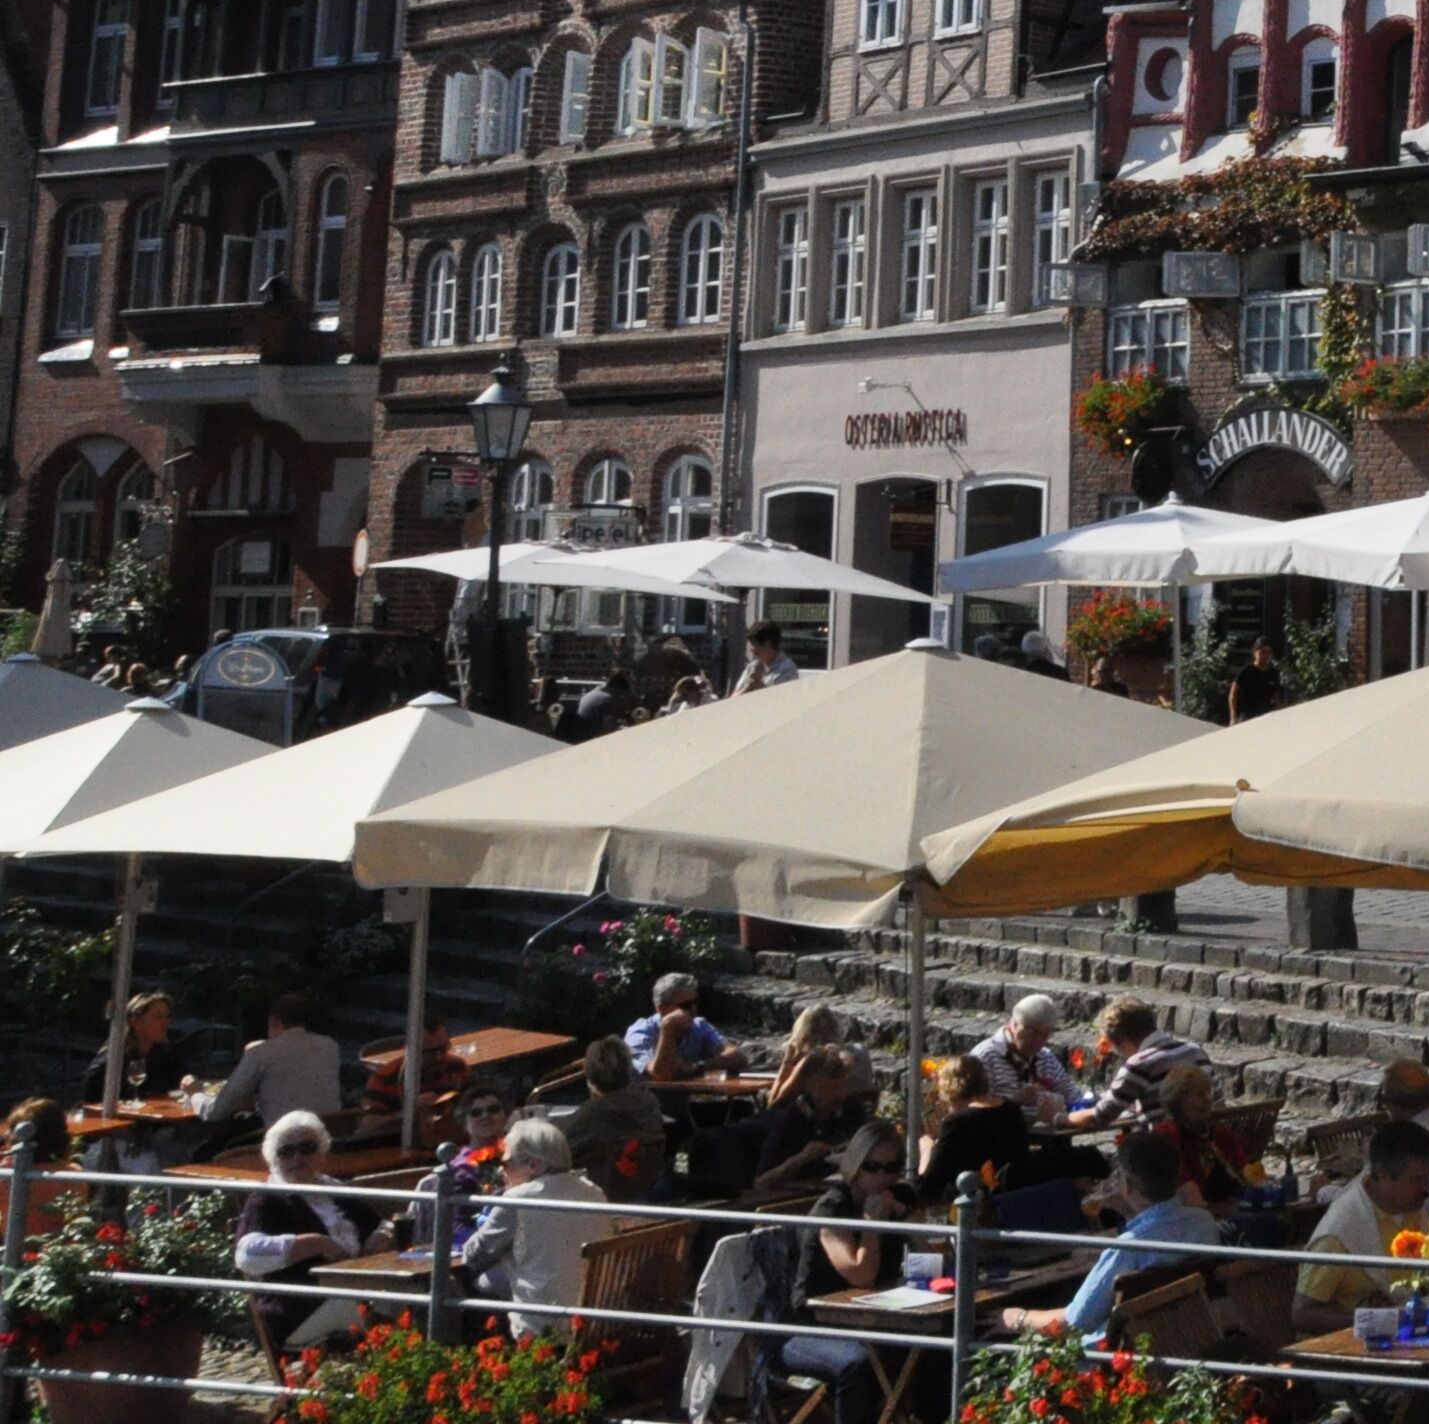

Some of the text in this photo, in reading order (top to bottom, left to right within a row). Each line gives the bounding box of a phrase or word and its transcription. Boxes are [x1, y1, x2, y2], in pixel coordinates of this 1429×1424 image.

[844, 408, 966, 447] OSTERIA RUSTICA
[1196, 410, 1349, 485] SCHALLANDER
